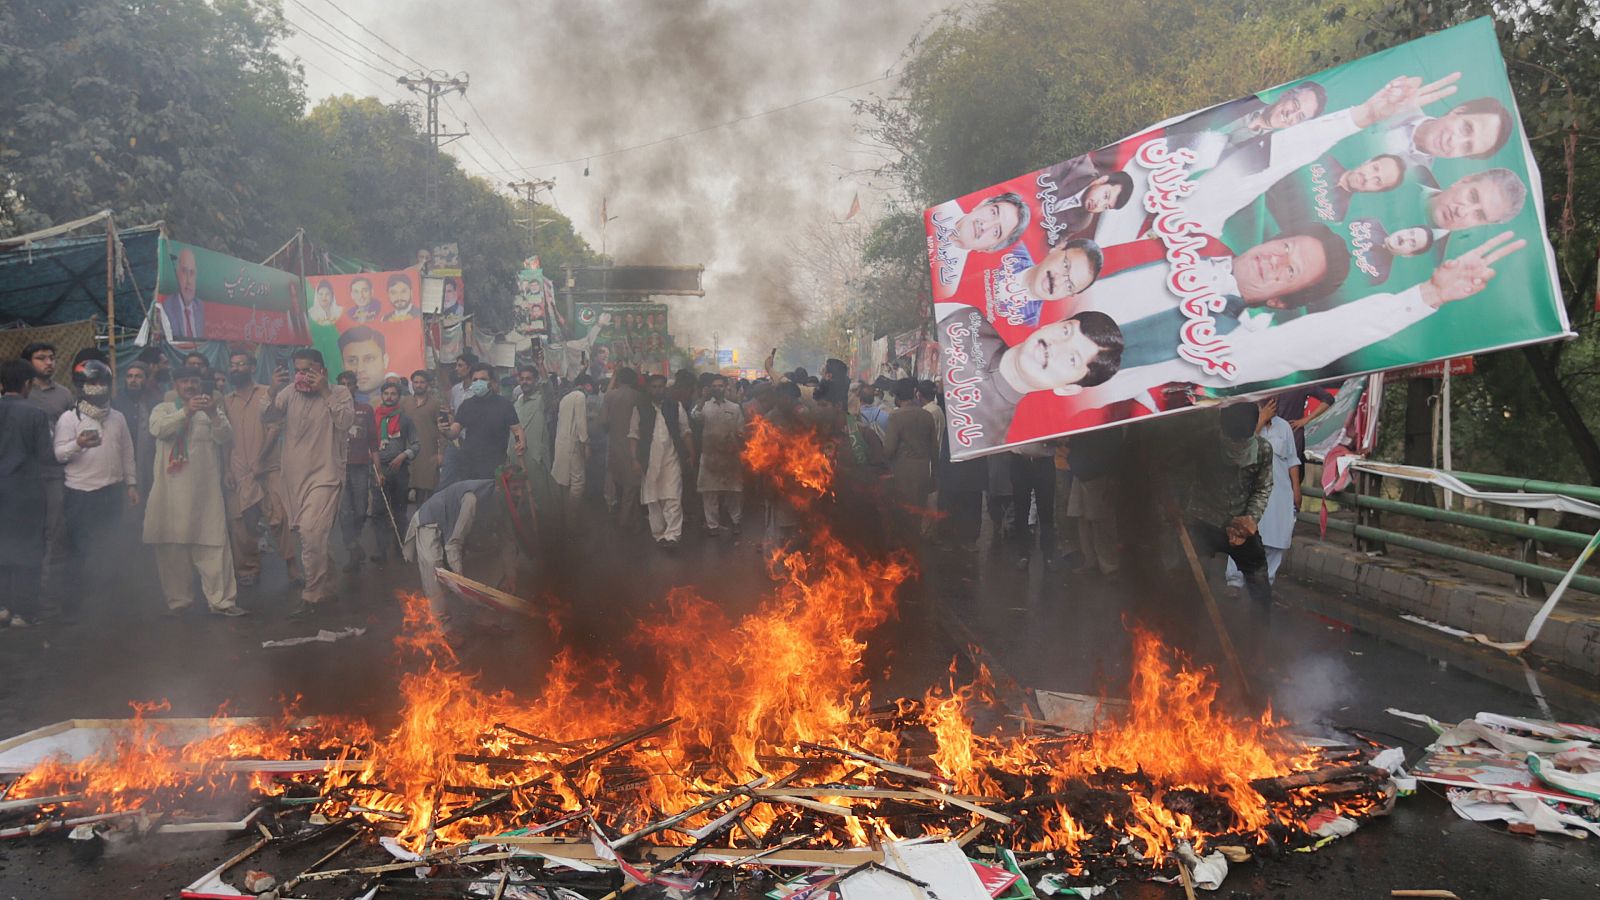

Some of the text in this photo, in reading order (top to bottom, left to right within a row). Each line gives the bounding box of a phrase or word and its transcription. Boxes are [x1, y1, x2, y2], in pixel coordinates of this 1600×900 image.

[1036, 173, 1058, 204] عباس
[1156, 210, 1204, 269] ہماری
[1171, 266, 1223, 318] خان
[1180, 319, 1238, 377] عمران
[944, 322, 984, 447] طاہر اقبال چوہدری
